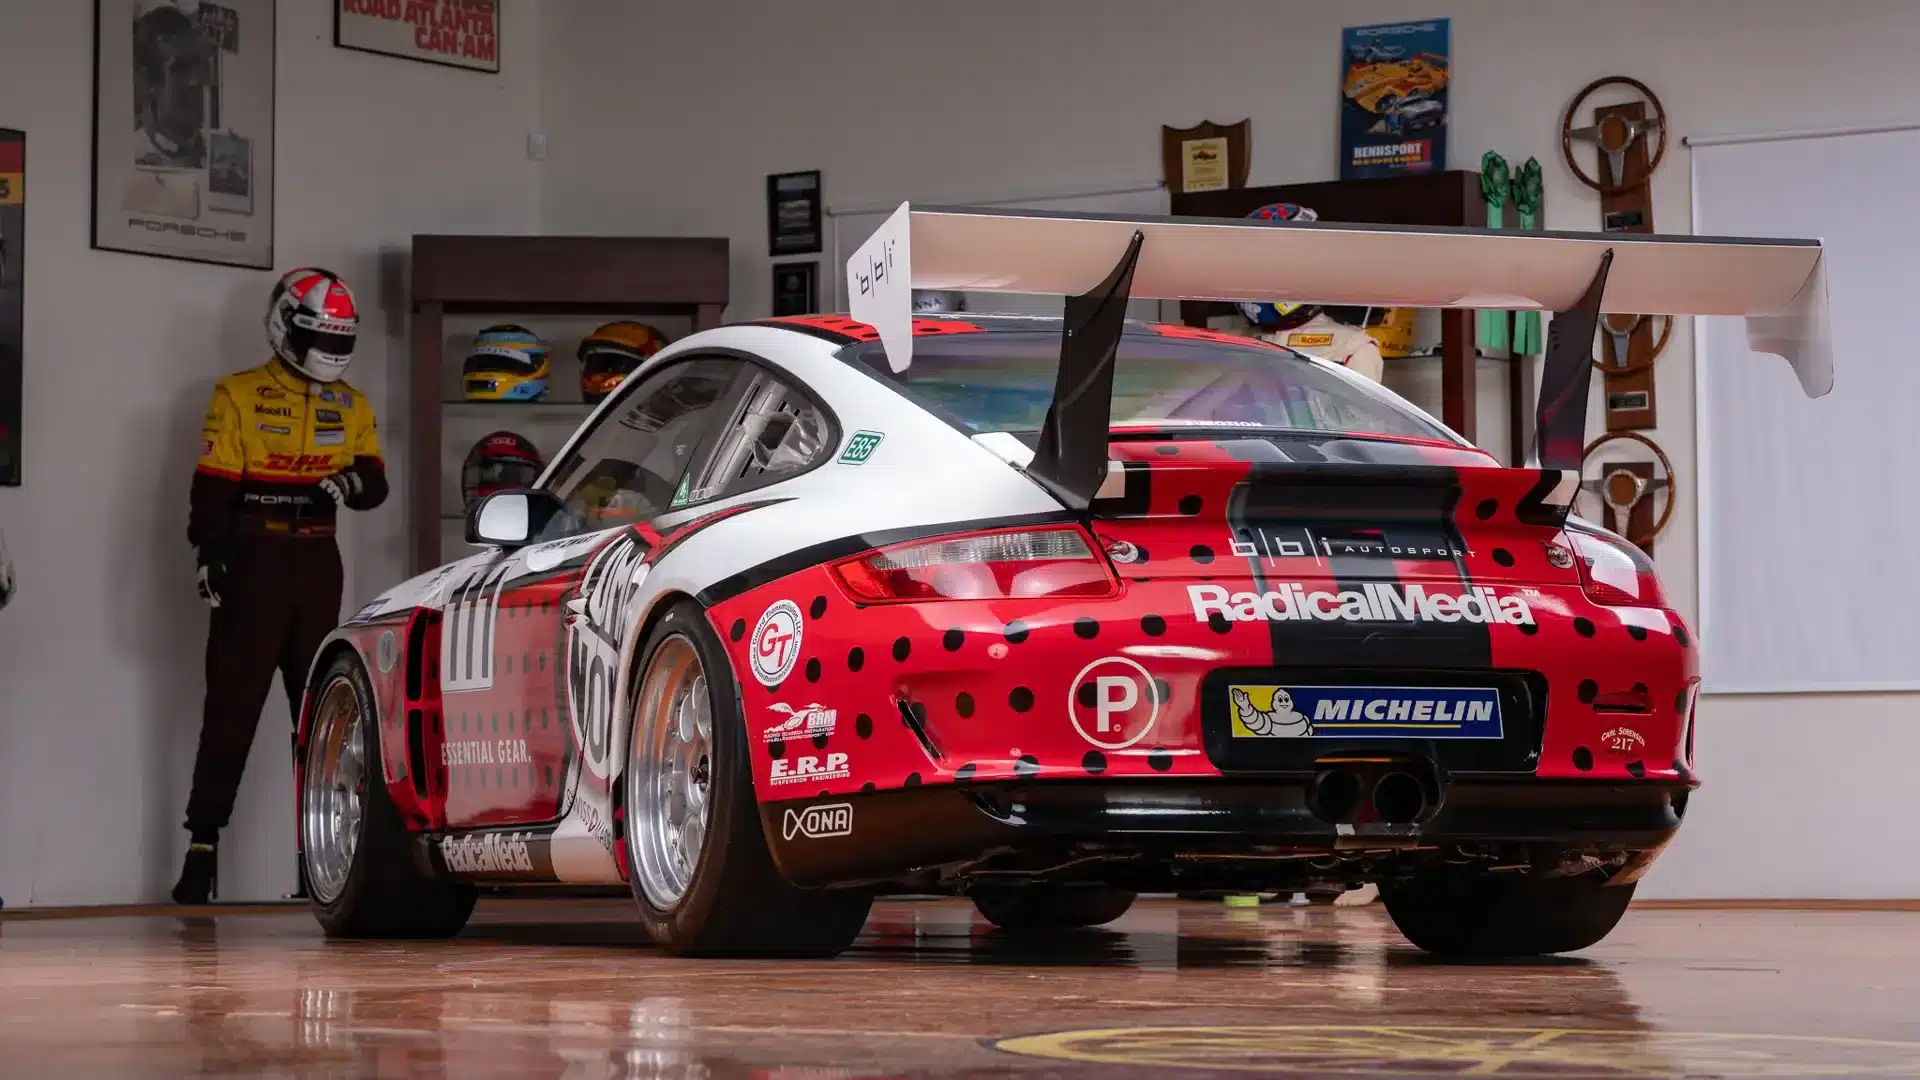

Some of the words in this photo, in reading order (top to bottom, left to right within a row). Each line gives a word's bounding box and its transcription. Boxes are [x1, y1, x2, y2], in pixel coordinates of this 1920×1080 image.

[404, 0, 495, 36] ATLANTA
[1354, 143, 1422, 157] RENNSPORT
[129, 218, 247, 242] PORSCHE
[845, 436, 877, 459] E85
[264, 454, 333, 472] DHL
[1344, 545, 1476, 558] AUTOSPORT
[752, 619, 766, 645] Guard
[759, 623, 792, 668] GT
[807, 709, 837, 728] BRM
[1313, 699, 1493, 722] MICHELIN
[1601, 729, 1617, 742] CARL
[1618, 726, 1646, 747] SORENSEN
[1612, 737, 1635, 751] 217
[441, 740, 494, 766] ESSENTIAL
[497, 739, 531, 764] GEAR.
[770, 752, 849, 778] E.R.P.
[770, 776, 807, 786] SUSPENSION
[812, 772, 851, 782] ENGINEERING
